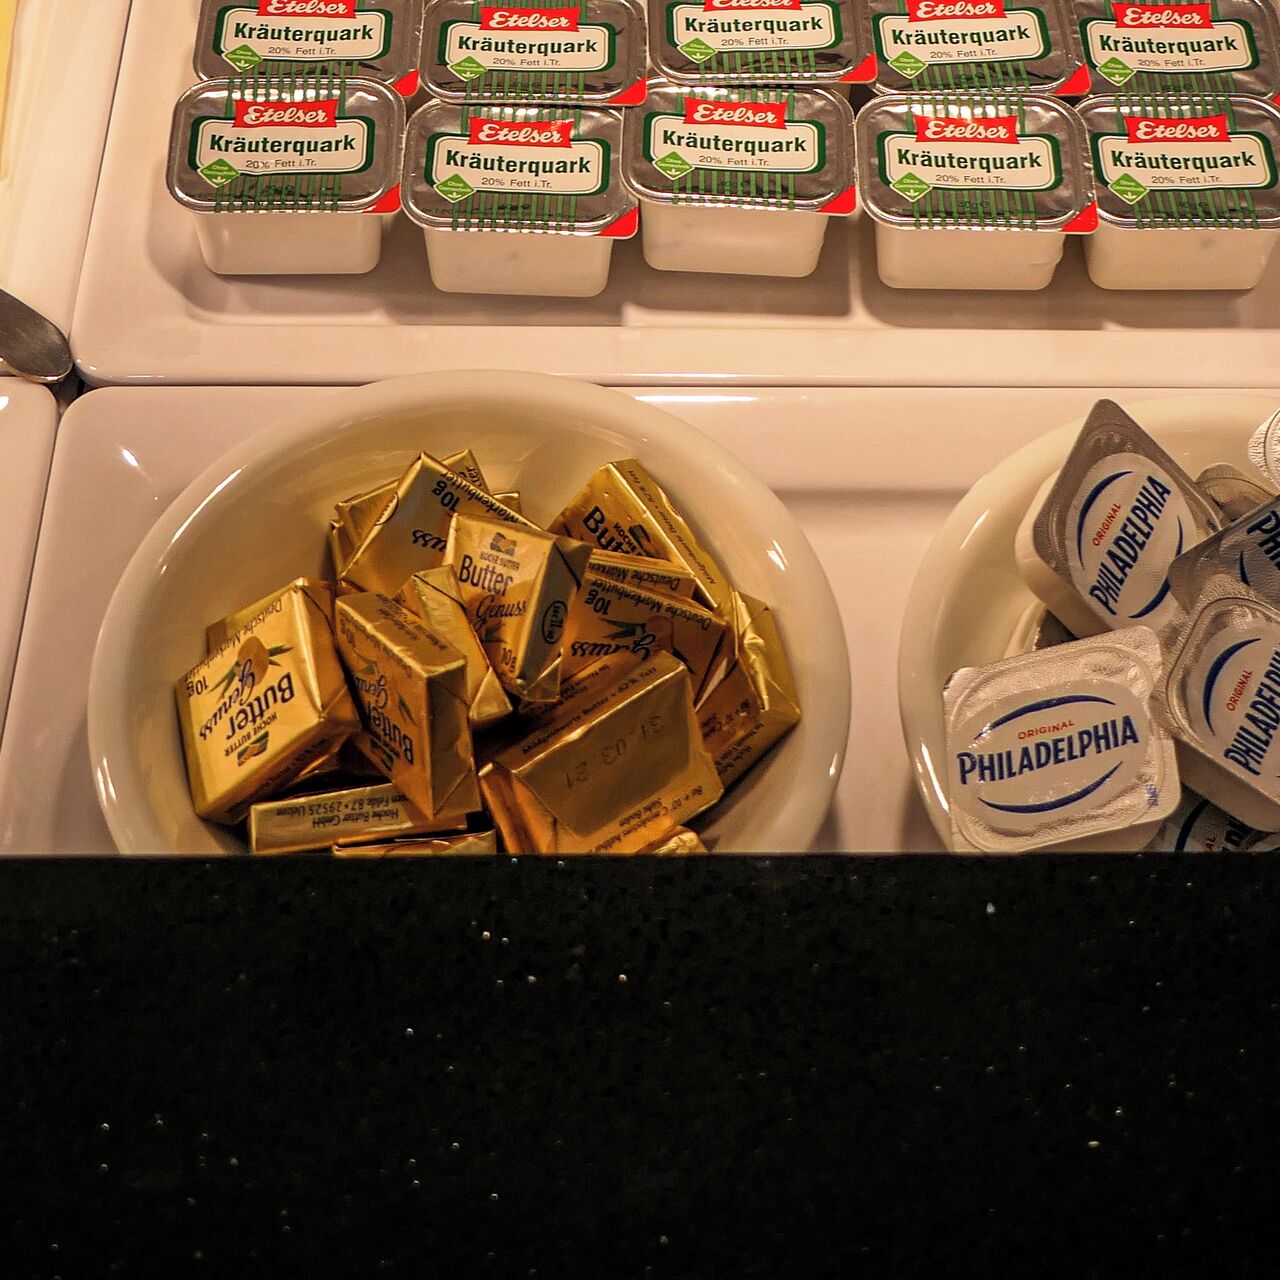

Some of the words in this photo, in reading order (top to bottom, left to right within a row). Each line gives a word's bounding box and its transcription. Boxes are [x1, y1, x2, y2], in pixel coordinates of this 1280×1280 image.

[916, 1, 996, 18] Etelser
[1123, 8, 1203, 26] Etelser
[488, 12, 570, 29] Etelser
[685, 16, 823, 35] Kräuterquark
[234, 22, 373, 43] Kräuterquark
[721, 38, 744, 46] 20%
[748, 37, 768, 46] Fett
[892, 25, 1030, 46] Kräuterquark
[268, 46, 291, 54] 20%
[296, 47, 315, 55] Fett
[458, 37, 597, 56] Kräuterquark
[931, 50, 952, 58] 20%
[957, 50, 977, 58] Fett
[1100, 35, 1237, 55] Kräuterquark
[493, 58, 515, 66] 20%
[520, 58, 540, 66] Fett
[1138, 58, 1160, 67] 20%
[1164, 59, 1184, 67] Fett
[243, 105, 328, 125] Etelser
[693, 104, 778, 125] Etelser
[478, 124, 563, 144] Etelser
[925, 122, 1010, 140] Etelser
[1135, 122, 1220, 140] Etelser
[210, 134, 355, 156] Kräuterquark
[663, 130, 807, 156] Kräuterquark
[246, 160, 270, 169] 20%
[275, 159, 295, 168] Fett
[446, 150, 591, 176] Kräuterquark
[699, 155, 722, 165] 20%
[728, 157, 748, 166] Fett
[897, 149, 1042, 171] Kräuterquark
[1111, 149, 1255, 172] Kräuterquark
[481, 177, 505, 186] 20%
[510, 178, 530, 187] Fett
[935, 174, 959, 183] 20%
[964, 175, 984, 184] Fett
[1151, 175, 1175, 184] 20%
[1180, 175, 1200, 184] Fett
[1092, 503, 1121, 546] ORIGINAL
[1089, 475, 1171, 615] PHILADELPHIA
[459, 554, 514, 597] Butter
[588, 562, 629, 583] Marken
[631, 572, 680, 591] Deutsche
[584, 588, 611, 615] 10g
[474, 595, 527, 631] Genuss
[666, 605, 711, 630] Deutsche
[199, 658, 255, 741] Genuss
[1226, 670, 1253, 711] ORIGINAL
[225, 672, 295, 738] Butter
[1017, 720, 1075, 740] ORIGINAL
[224, 730, 252, 757] BUTTER
[956, 715, 1139, 785] PHILADELPHIA
